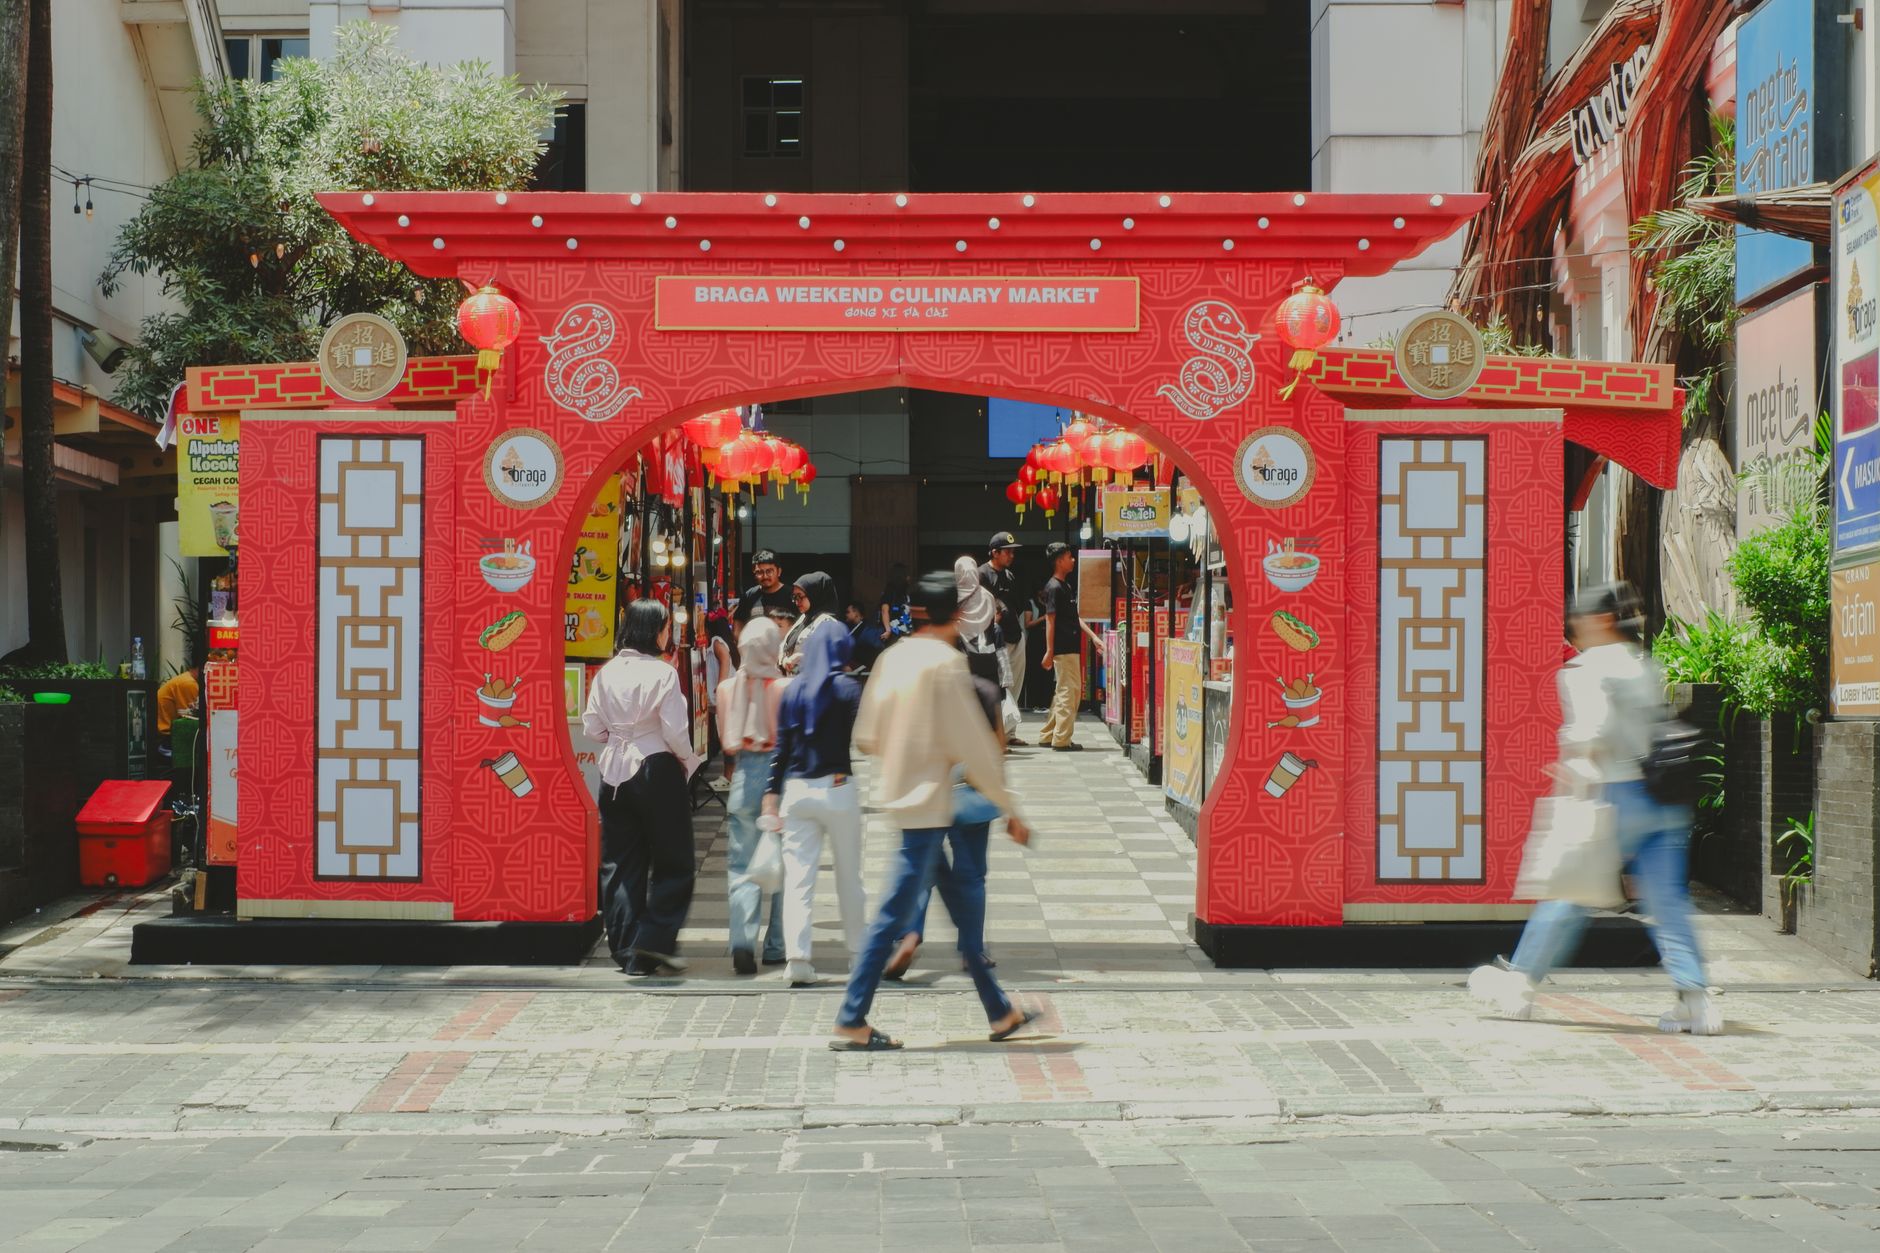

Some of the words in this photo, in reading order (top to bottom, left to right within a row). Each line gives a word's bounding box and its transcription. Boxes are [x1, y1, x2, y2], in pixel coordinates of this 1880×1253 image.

[1746, 51, 1807, 149] meet
[695, 286, 770, 303] BRAGA
[776, 287, 883, 303] WEEKEND
[889, 287, 1002, 304] CULINARY
[1008, 287, 1099, 304] MARKET
[844, 307, 877, 318] GONG
[882, 307, 897, 318] XI
[903, 306, 920, 318] FA
[925, 306, 949, 318] CAI
[1746, 364, 1809, 447] meet
[182, 417, 220, 435] ONE
[188, 439, 239, 458] Alpukat
[191, 455, 238, 473] Kocok
[193, 477, 220, 485] CEGAH
[502, 465, 547, 487] braga
[1252, 464, 1298, 486] braga
[1138, 508, 1155, 519] Teh
[1845, 566, 1870, 584] GRAND
[1842, 593, 1876, 647] dafam
[216, 630, 239, 640] BAKS
[1840, 687, 1860, 702] LOBBY
[1861, 685, 1880, 701] HOTE
